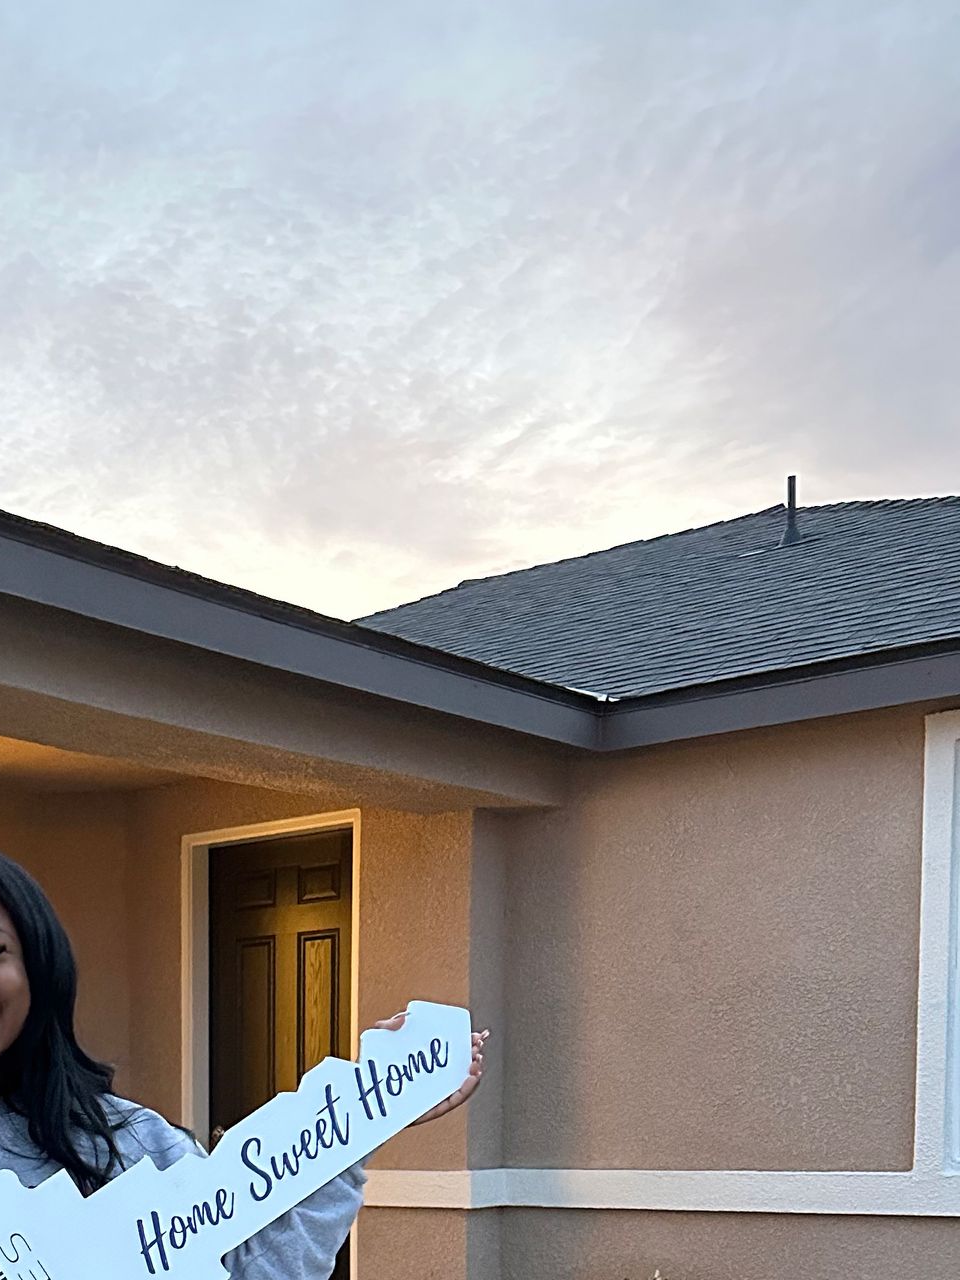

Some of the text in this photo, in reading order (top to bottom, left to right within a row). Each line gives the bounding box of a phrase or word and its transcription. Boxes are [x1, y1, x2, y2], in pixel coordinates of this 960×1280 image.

[136, 1037, 449, 1275] Home Sweet Home
